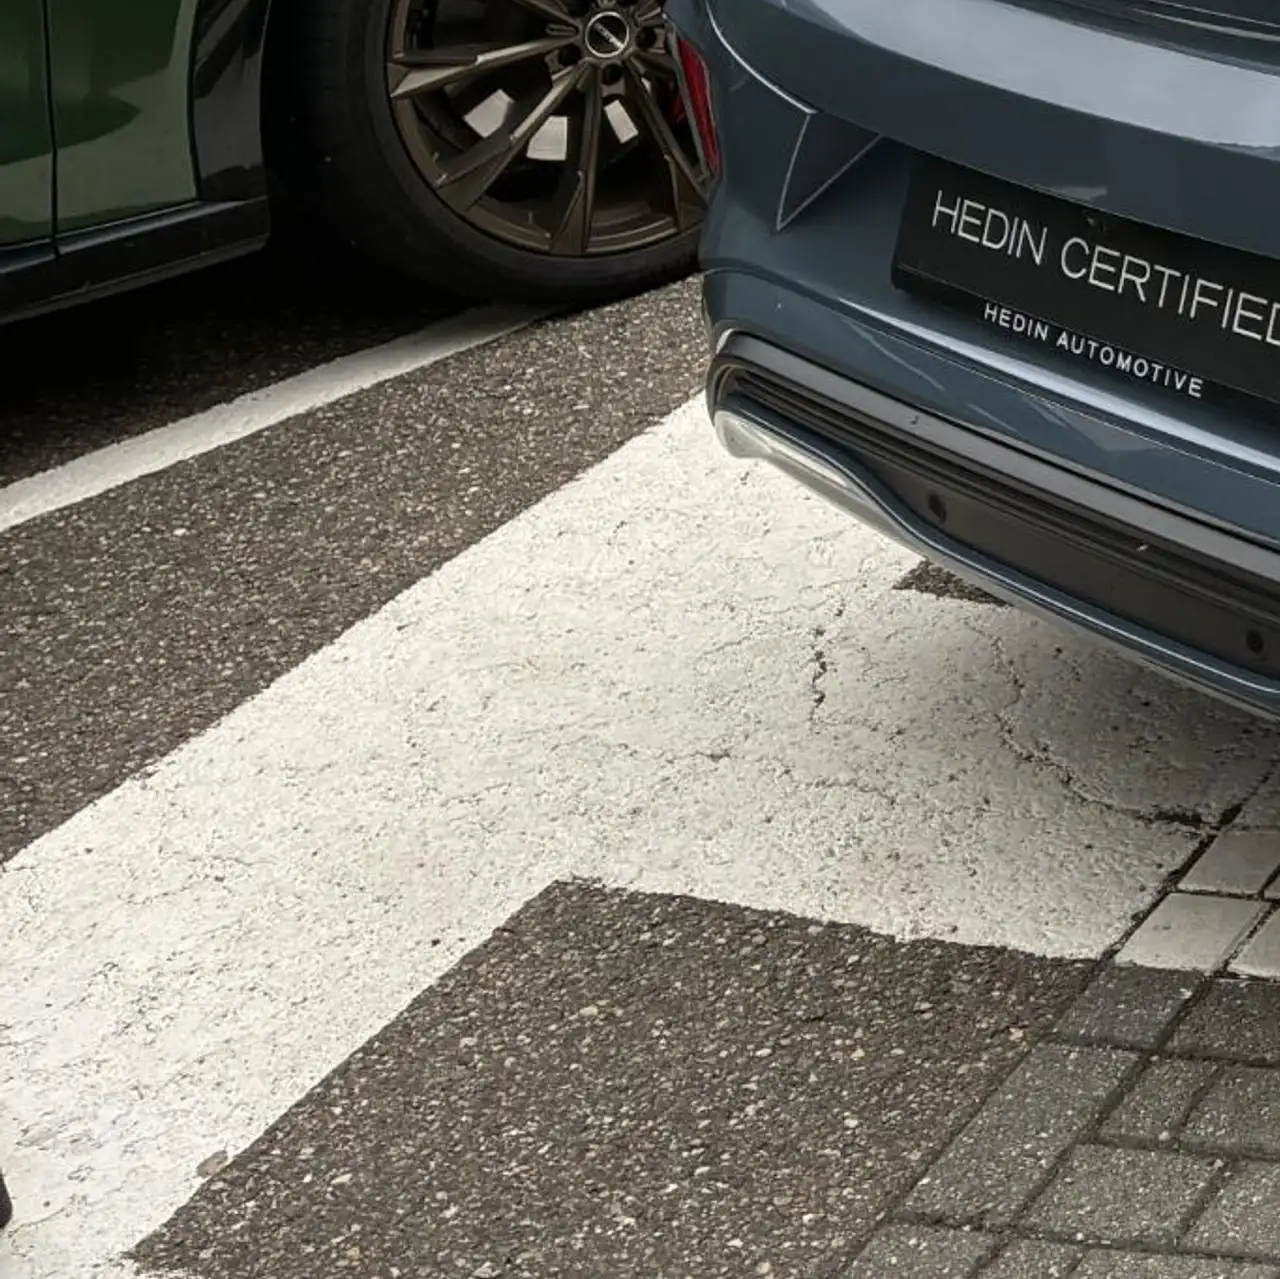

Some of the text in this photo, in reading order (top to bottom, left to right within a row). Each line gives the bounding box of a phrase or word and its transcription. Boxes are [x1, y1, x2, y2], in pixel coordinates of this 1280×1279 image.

[932, 190, 1048, 266] HEDIN
[983, 302, 1205, 399] HEDIN AUTOMOTIVE
